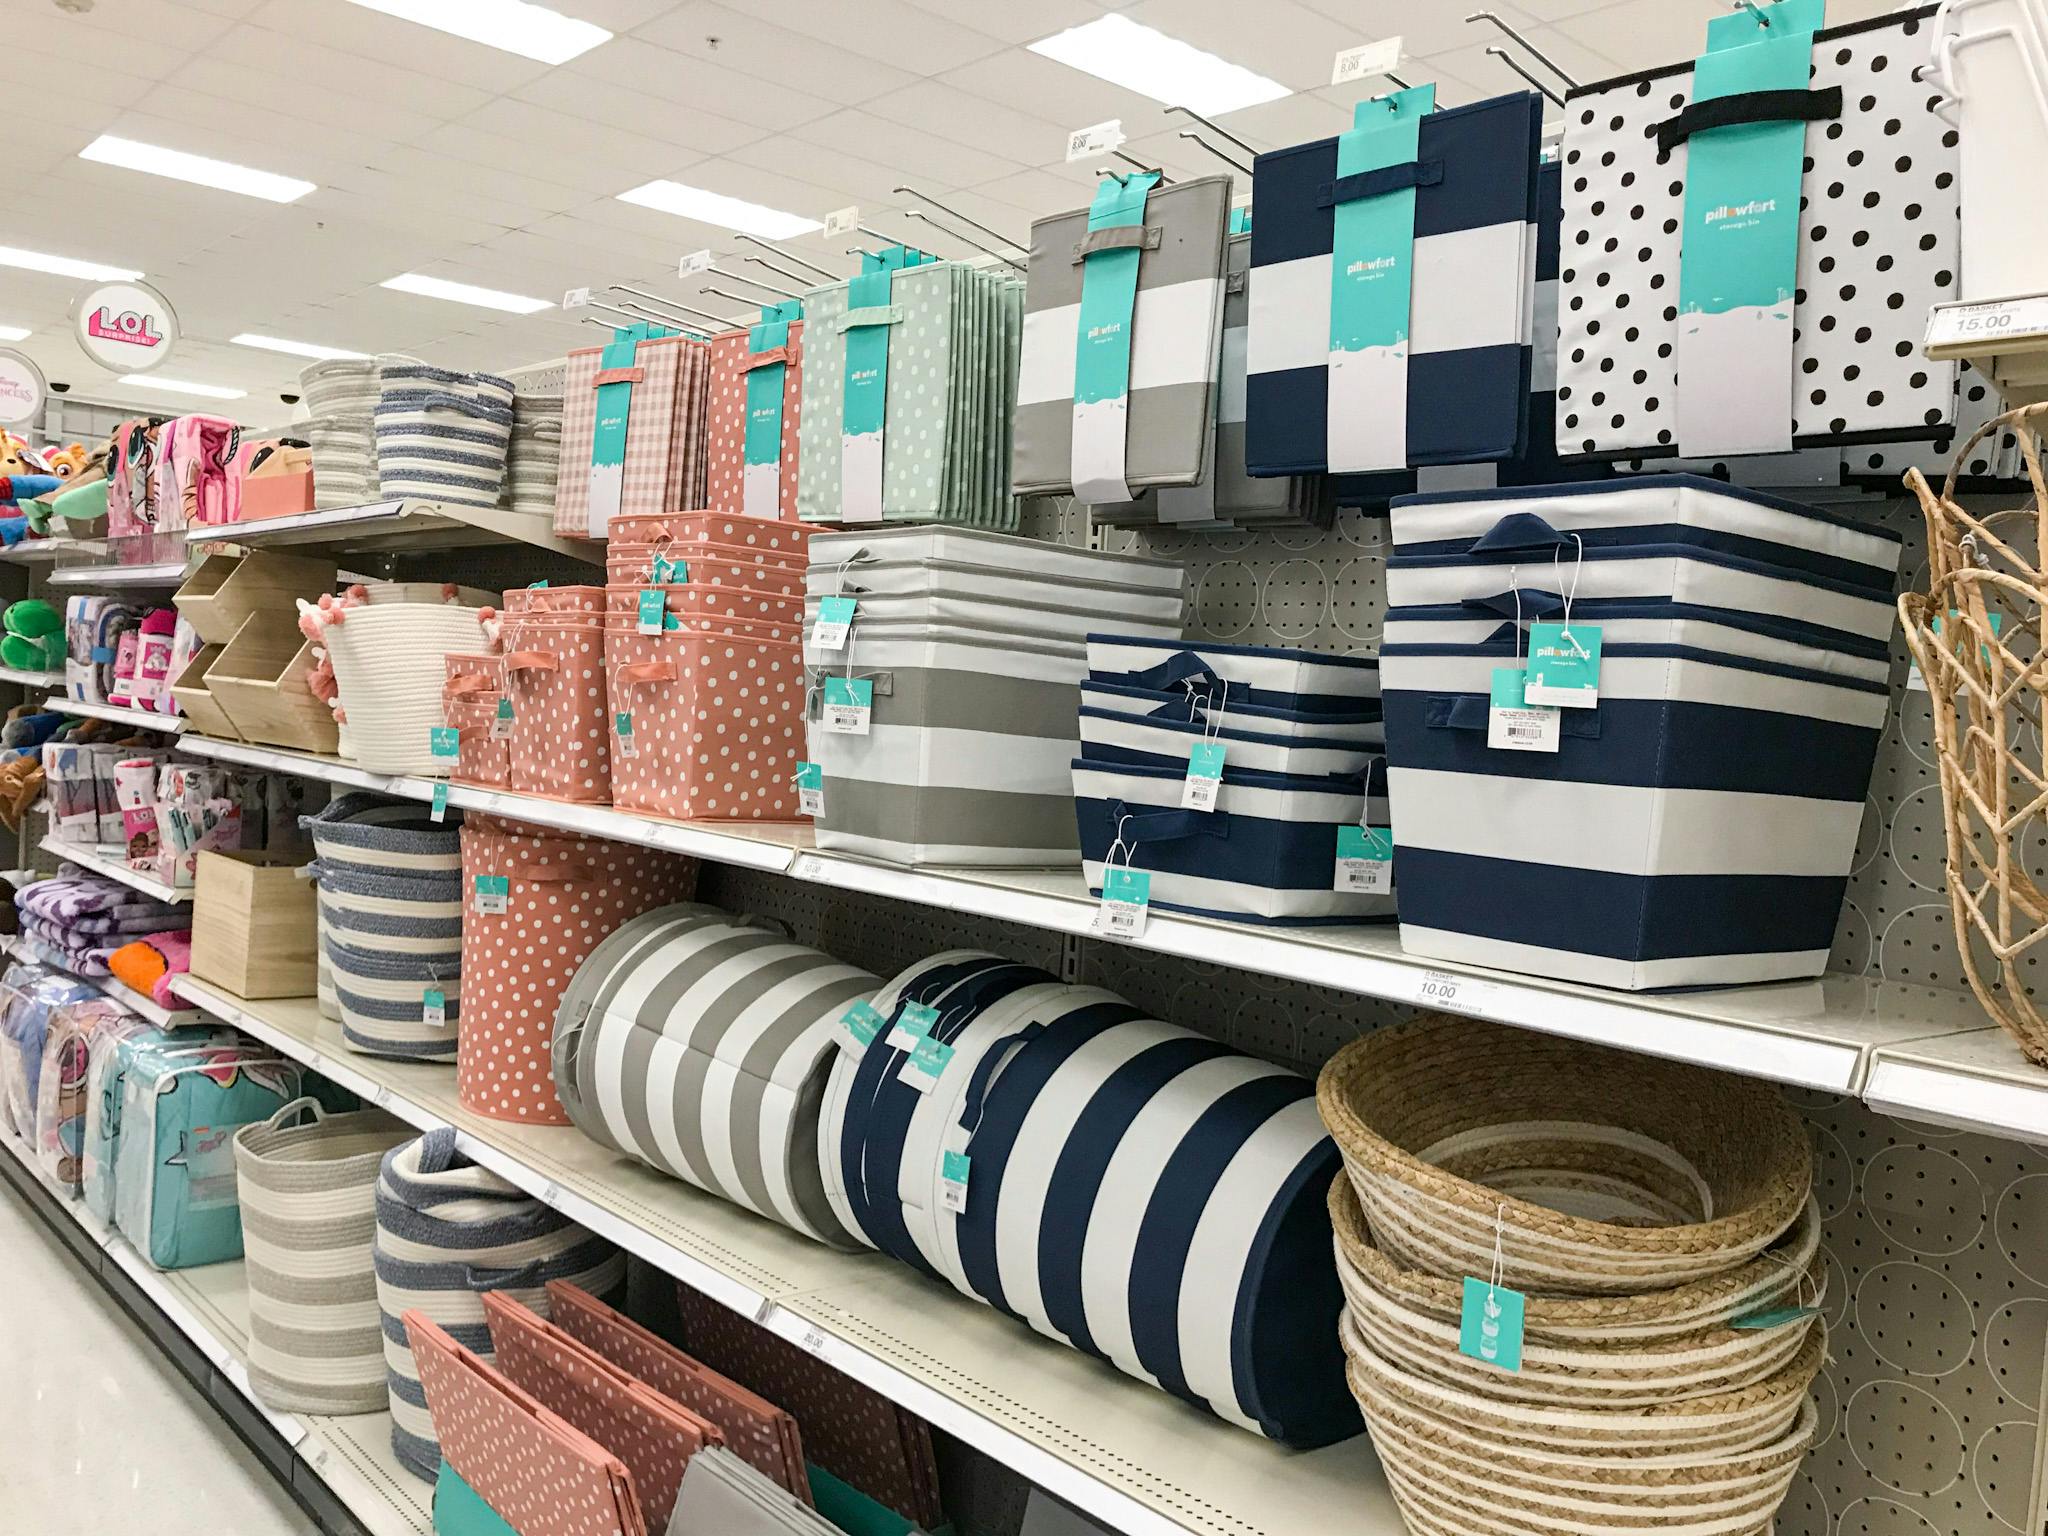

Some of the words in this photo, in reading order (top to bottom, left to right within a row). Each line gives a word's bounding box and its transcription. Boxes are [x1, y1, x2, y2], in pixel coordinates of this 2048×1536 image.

[1705, 199, 1776, 225] pillowfort
[1347, 256, 1396, 277] pillowfort
[1956, 314, 2011, 331] 15.00
[1421, 982, 1456, 999] 10.00
